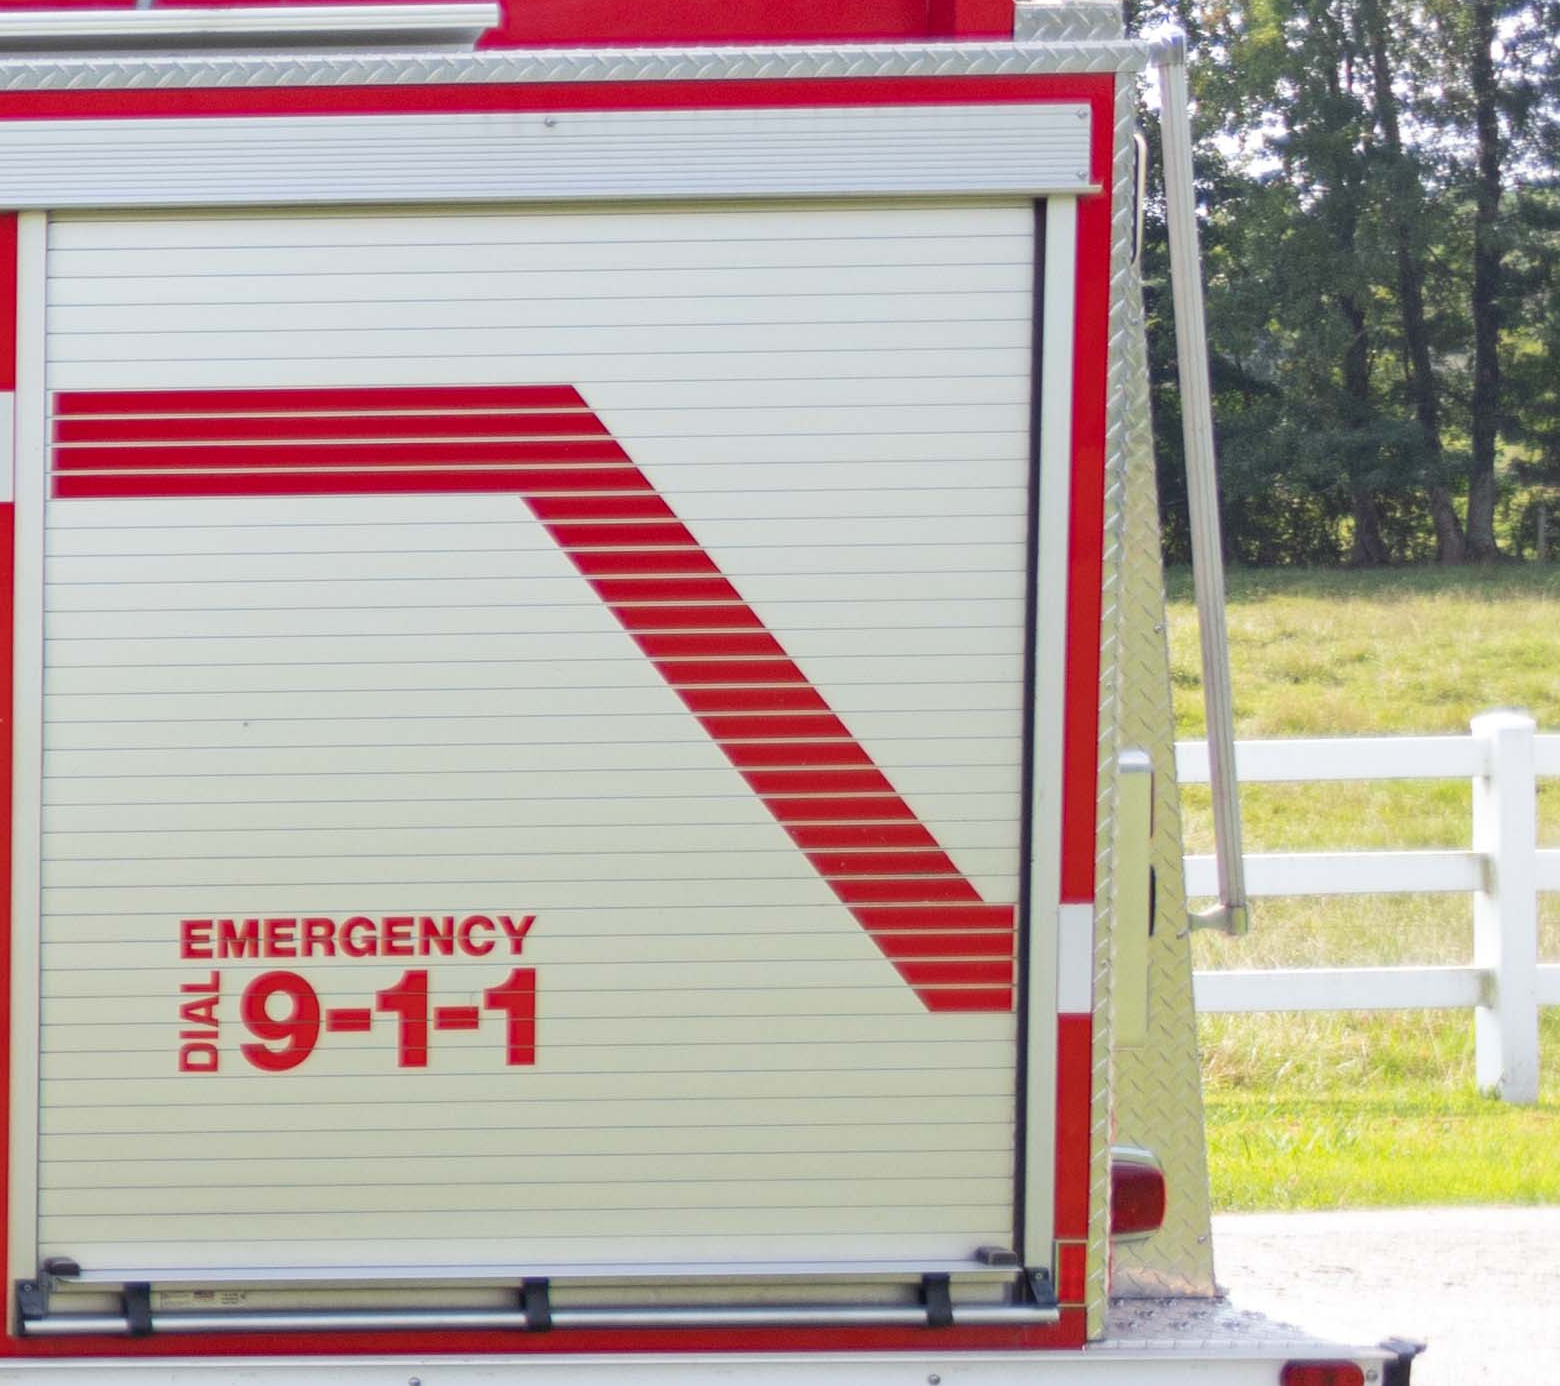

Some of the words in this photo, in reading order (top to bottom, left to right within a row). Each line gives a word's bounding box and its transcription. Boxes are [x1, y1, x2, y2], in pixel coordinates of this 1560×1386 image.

[179, 915, 537, 959] EMERGENCY
[178, 970, 222, 1072] DIAL
[239, 967, 537, 1072] 9-1-1
